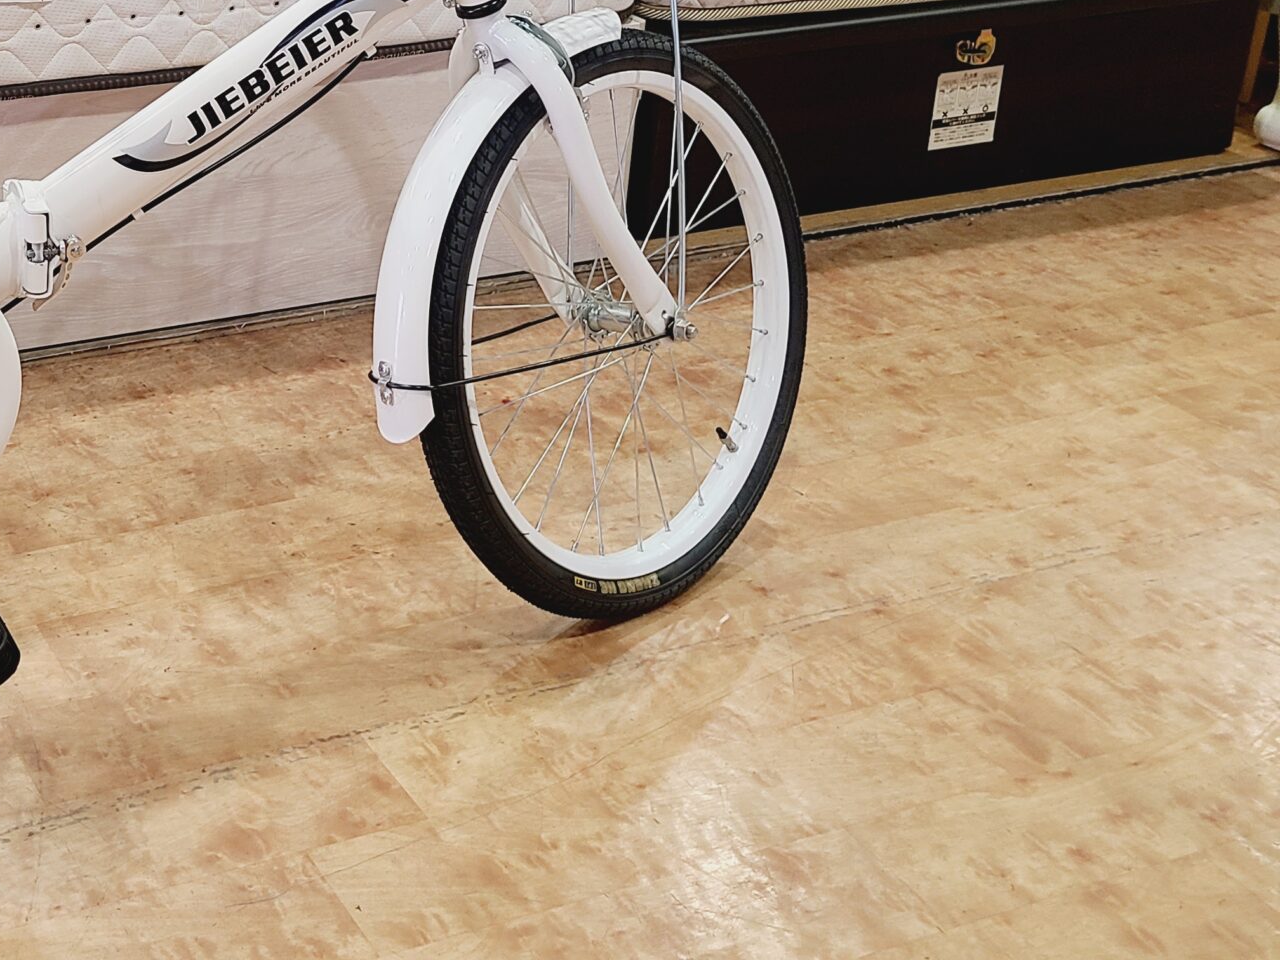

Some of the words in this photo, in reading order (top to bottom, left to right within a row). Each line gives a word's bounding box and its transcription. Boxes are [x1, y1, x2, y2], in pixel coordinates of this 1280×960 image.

[187, 11, 360, 144] JIEBEIER
[273, 76, 303, 98] MORE
[304, 38, 360, 78] BEAUTIFUL
